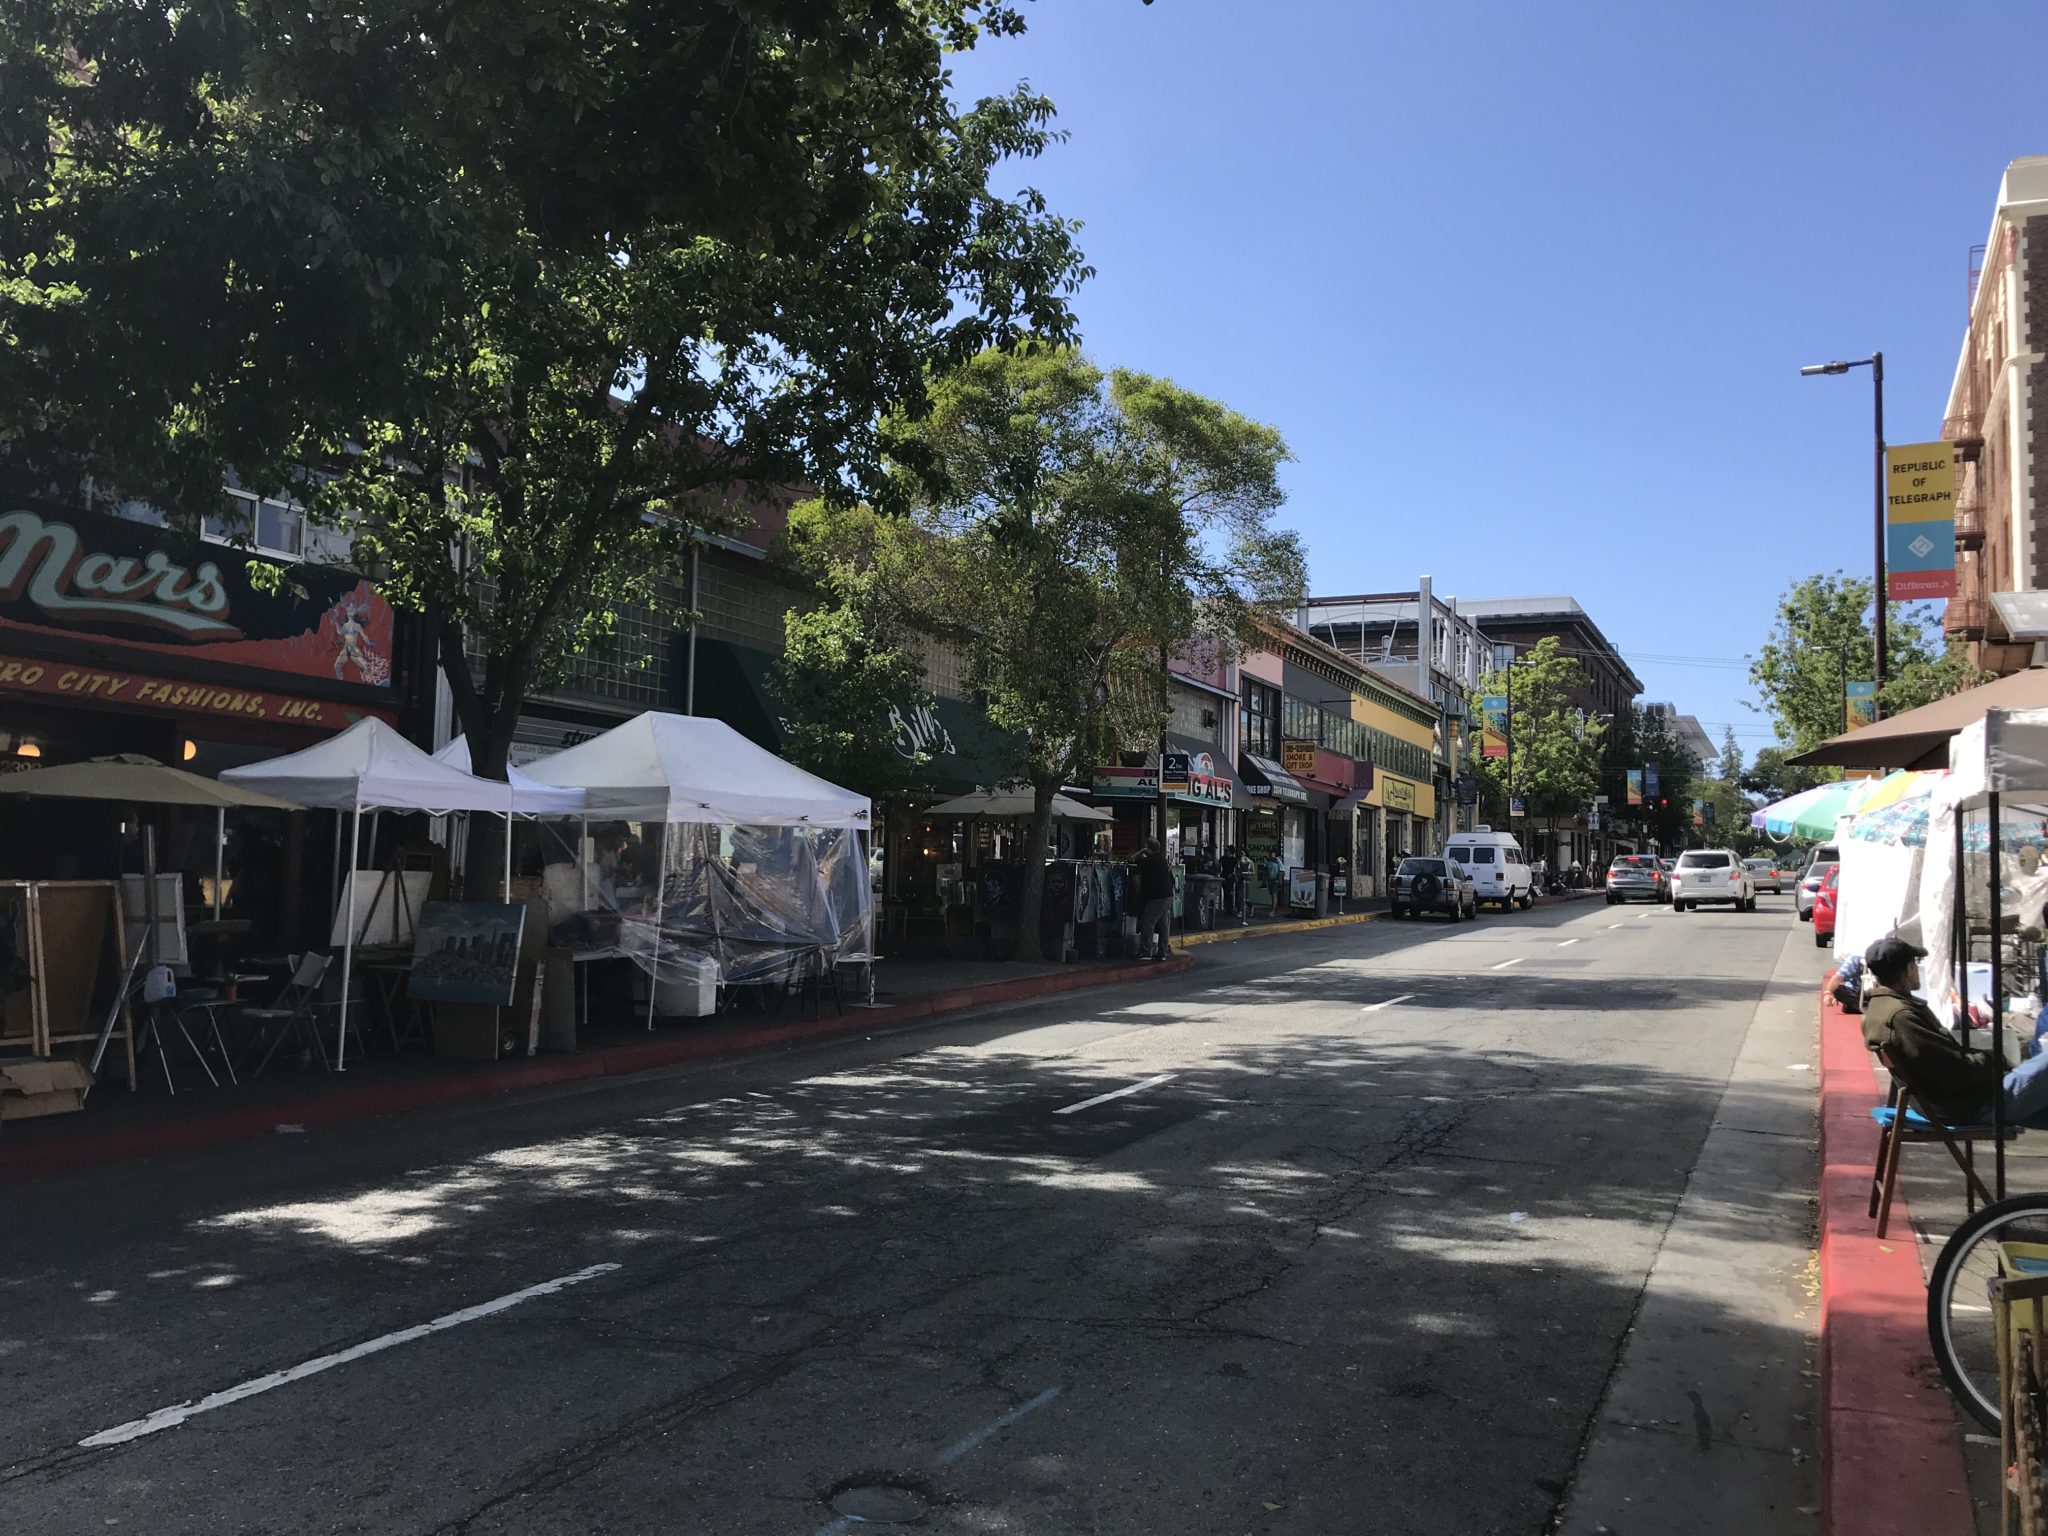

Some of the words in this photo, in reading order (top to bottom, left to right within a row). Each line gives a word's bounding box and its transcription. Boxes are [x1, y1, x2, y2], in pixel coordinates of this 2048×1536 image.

[1893, 460, 1946, 474] REPUBLIC
[1912, 477, 1927, 488] OF
[1888, 491, 1951, 505] TELEGRAPH
[0, 510, 238, 636] Mars
[0, 660, 44, 685] RO
[58, 670, 130, 696] CITY
[136, 681, 267, 718] FASHIONS,
[279, 700, 323, 721] INC.
[1168, 757, 1176, 769] 2
[1286, 753, 1306, 761] SMOKE
[1308, 753, 1313, 761] &
[1286, 761, 1297, 769] GIFT
[1299, 761, 1313, 769] SHOP
[1187, 776, 1201, 798] IG
[1205, 779, 1232, 803] AL'S
[1257, 785, 1271, 794] SHOP
